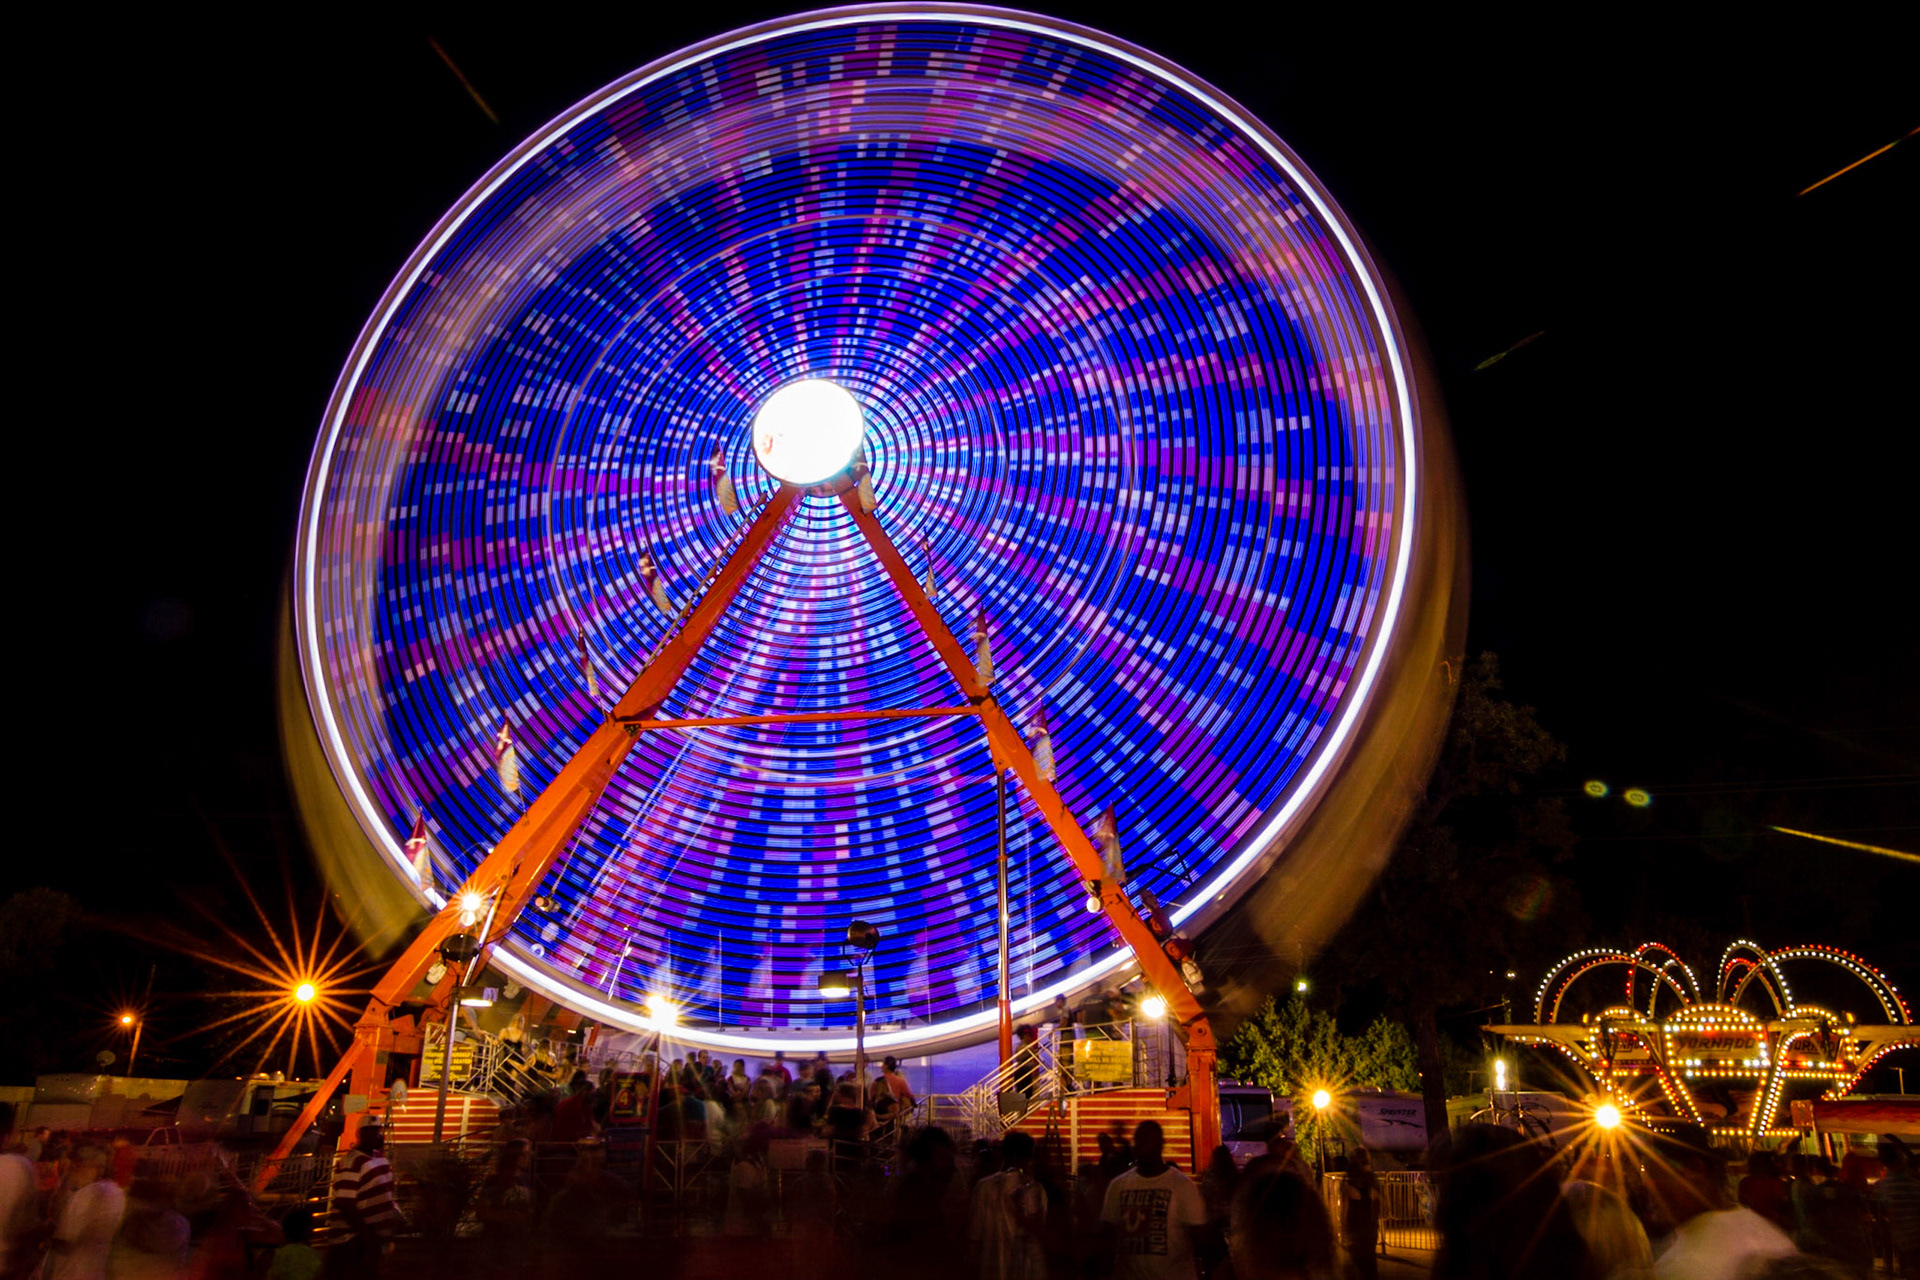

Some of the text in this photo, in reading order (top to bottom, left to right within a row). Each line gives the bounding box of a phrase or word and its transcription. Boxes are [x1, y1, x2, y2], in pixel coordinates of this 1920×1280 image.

[1675, 1035, 1756, 1054] TORNADO
[618, 1091, 630, 1106] 4
[1379, 1108, 1416, 1116] SPRINTER
[1121, 1190, 1151, 1206] TRUE
